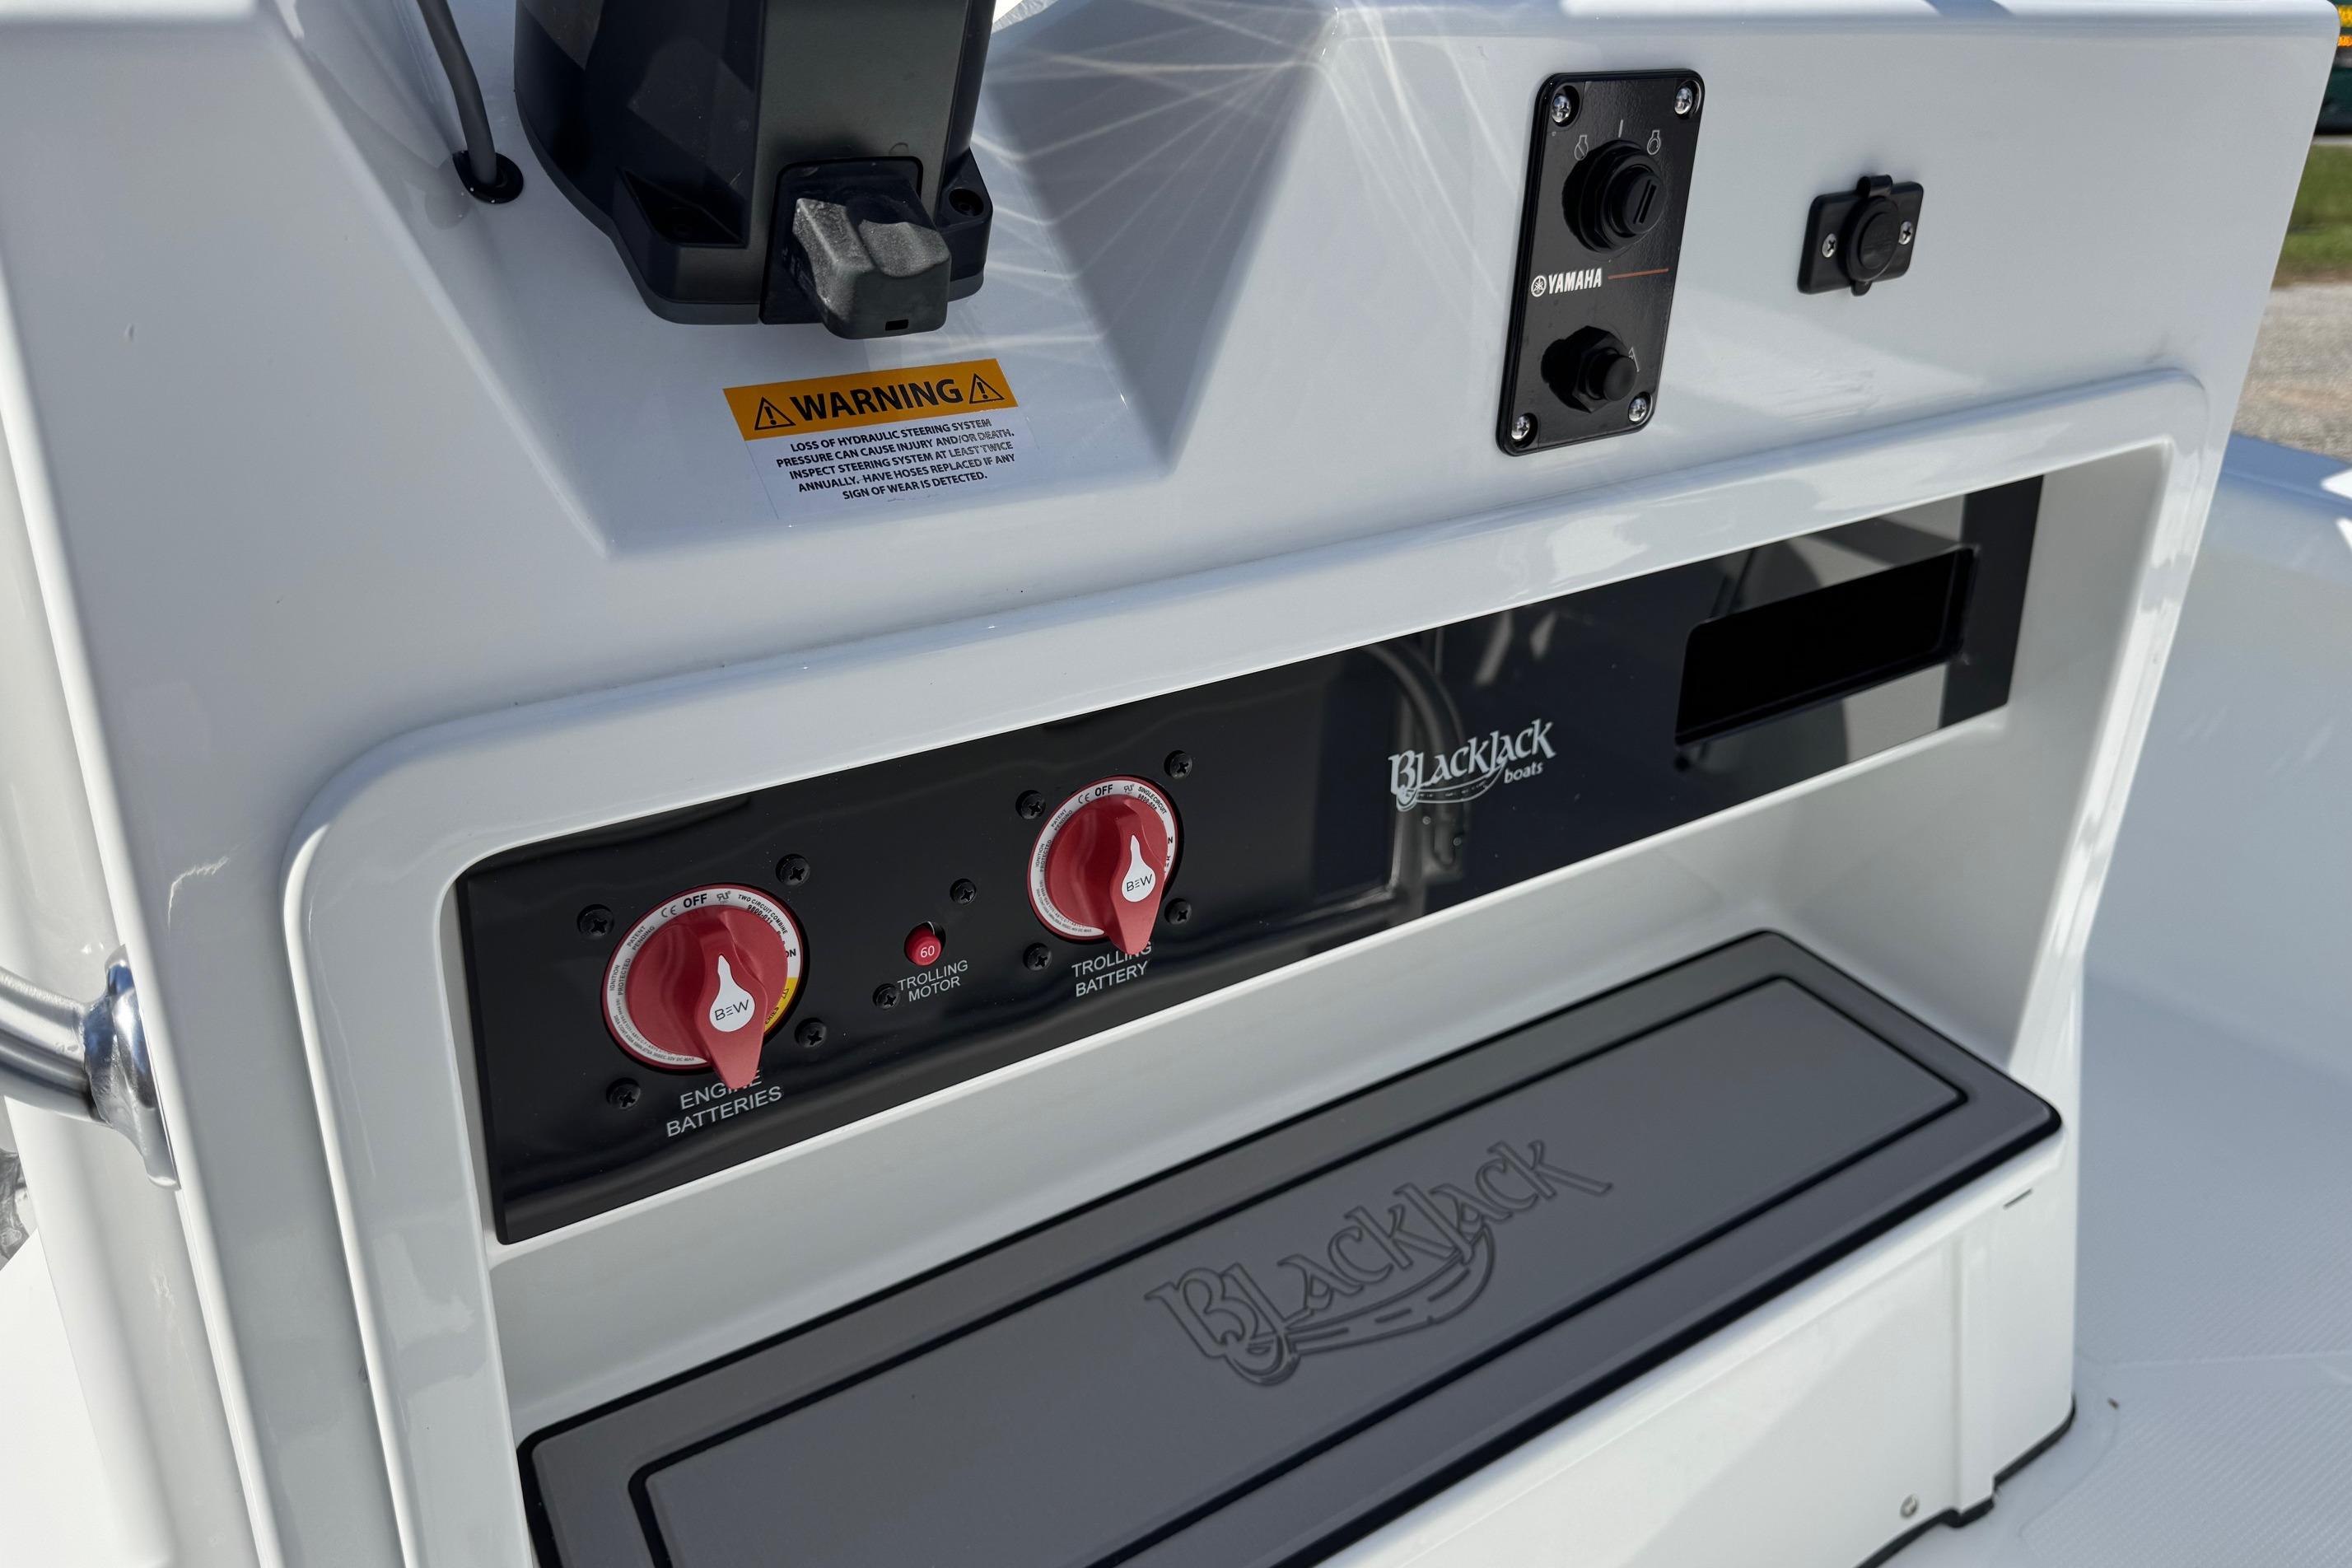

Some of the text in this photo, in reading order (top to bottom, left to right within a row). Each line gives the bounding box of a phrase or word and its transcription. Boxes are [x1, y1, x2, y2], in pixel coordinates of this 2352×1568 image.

[1548, 268, 1602, 294] YAMAHA
[790, 379, 963, 421] WARNING
[776, 428, 1015, 468] PRESSURE CAN CAUSE INJURY AND/OR DEATH.
[791, 418, 992, 452] LOSS OF HYDRAULIC STEERING SYSTEM
[789, 441, 1014, 480] INSPECT STEERING SYSTEM AT LEAST TWICE
[799, 453, 1015, 492] ANNUALLY. HAVE HOSES REPLACED IF ANY
[842, 471, 987, 500] SIGN OF WEAR IS DETECTED.
[1504, 761, 1544, 784] boats
[1094, 783, 1113, 796] OFF
[1152, 796, 1167, 814] CIRCUIT
[683, 893, 707, 908] OFF
[738, 894, 788, 935] TWO CIRCUIT COMBINE
[627, 926, 646, 947] PATENT
[632, 926, 656, 950] PENDING
[920, 945, 936, 958] 60
[609, 964, 620, 992] IGNITION
[618, 958, 632, 996] PROTECTED
[897, 959, 968, 991] TROLLING
[908, 976, 961, 1002] MOTOR
[1076, 960, 1148, 997] BATTERY
[666, 1085, 783, 1137] BATTERIES
